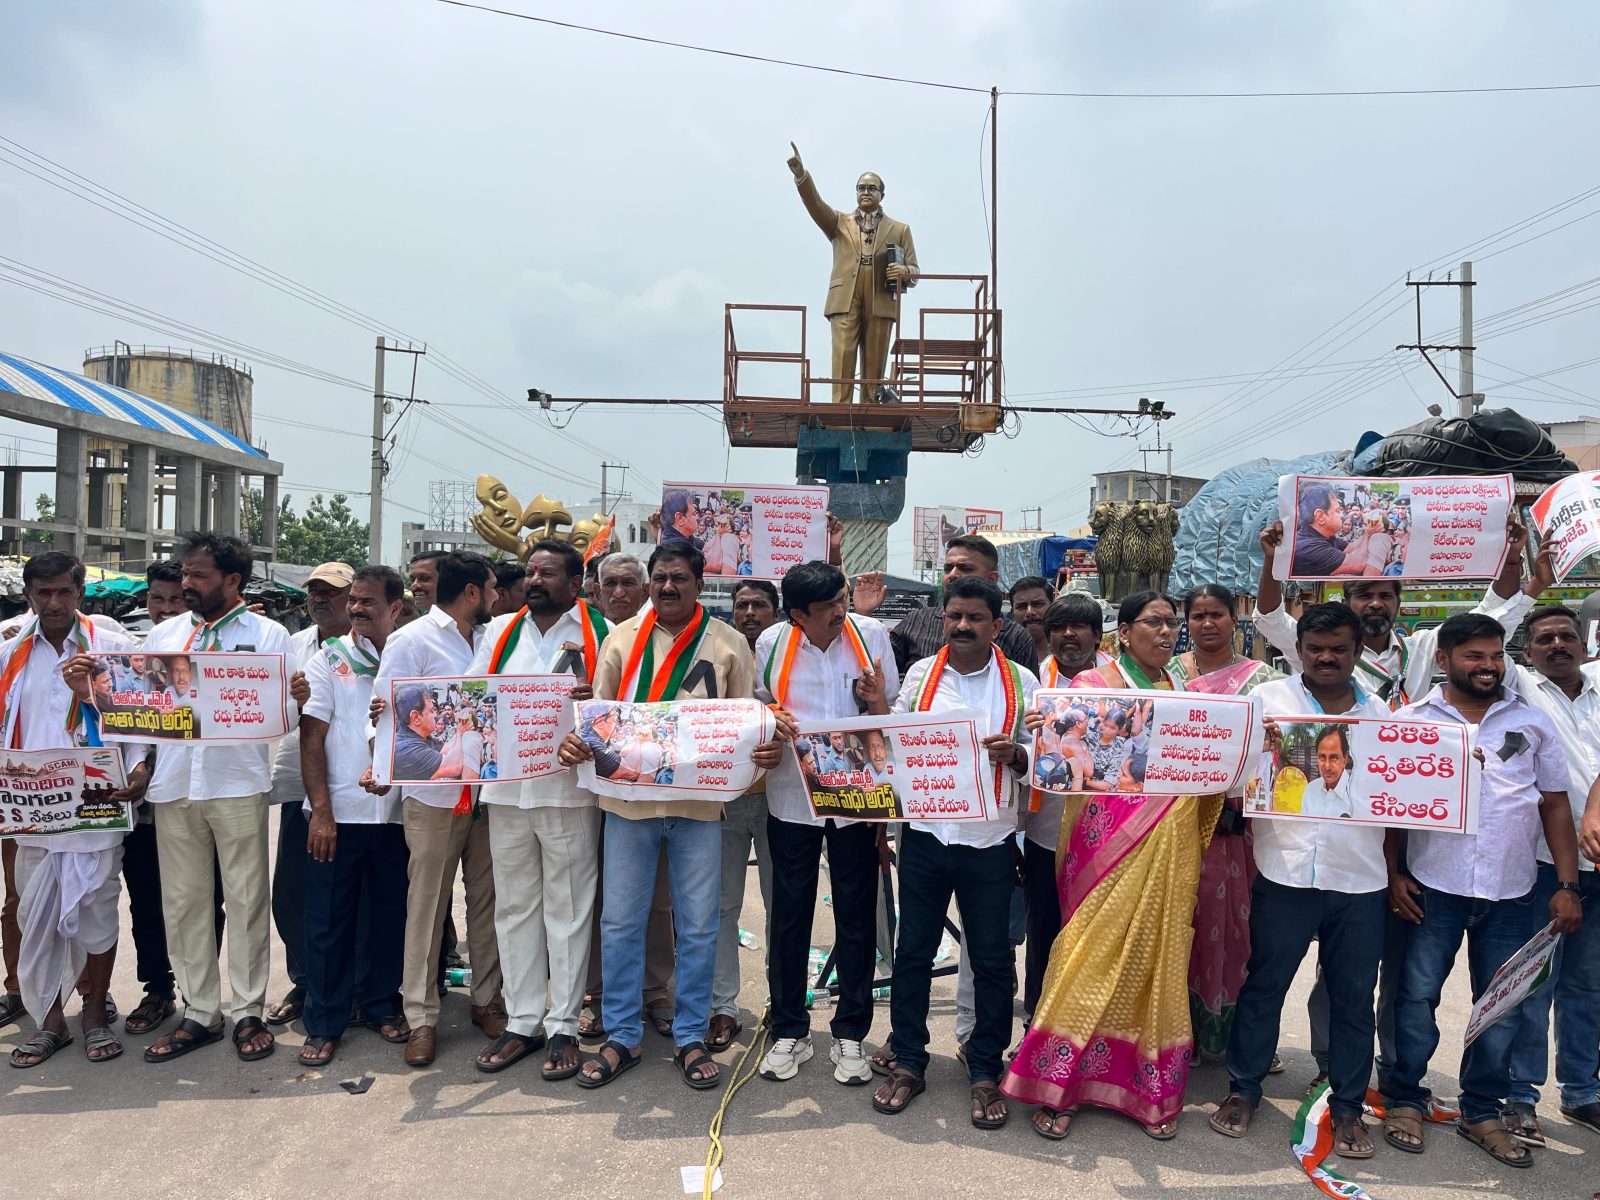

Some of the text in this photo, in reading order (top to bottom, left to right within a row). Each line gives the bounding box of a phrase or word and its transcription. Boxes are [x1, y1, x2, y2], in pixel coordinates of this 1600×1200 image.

[204, 667, 224, 679] MLC
[1189, 709, 1208, 722] BRS
[1378, 724, 1440, 744] దళిత
[48, 760, 76, 770] SCAM
[1368, 753, 1455, 782] వ్యతిరేకి
[1370, 792, 1448, 820] కేసిఆర్
[29, 810, 72, 823] నేతలు
